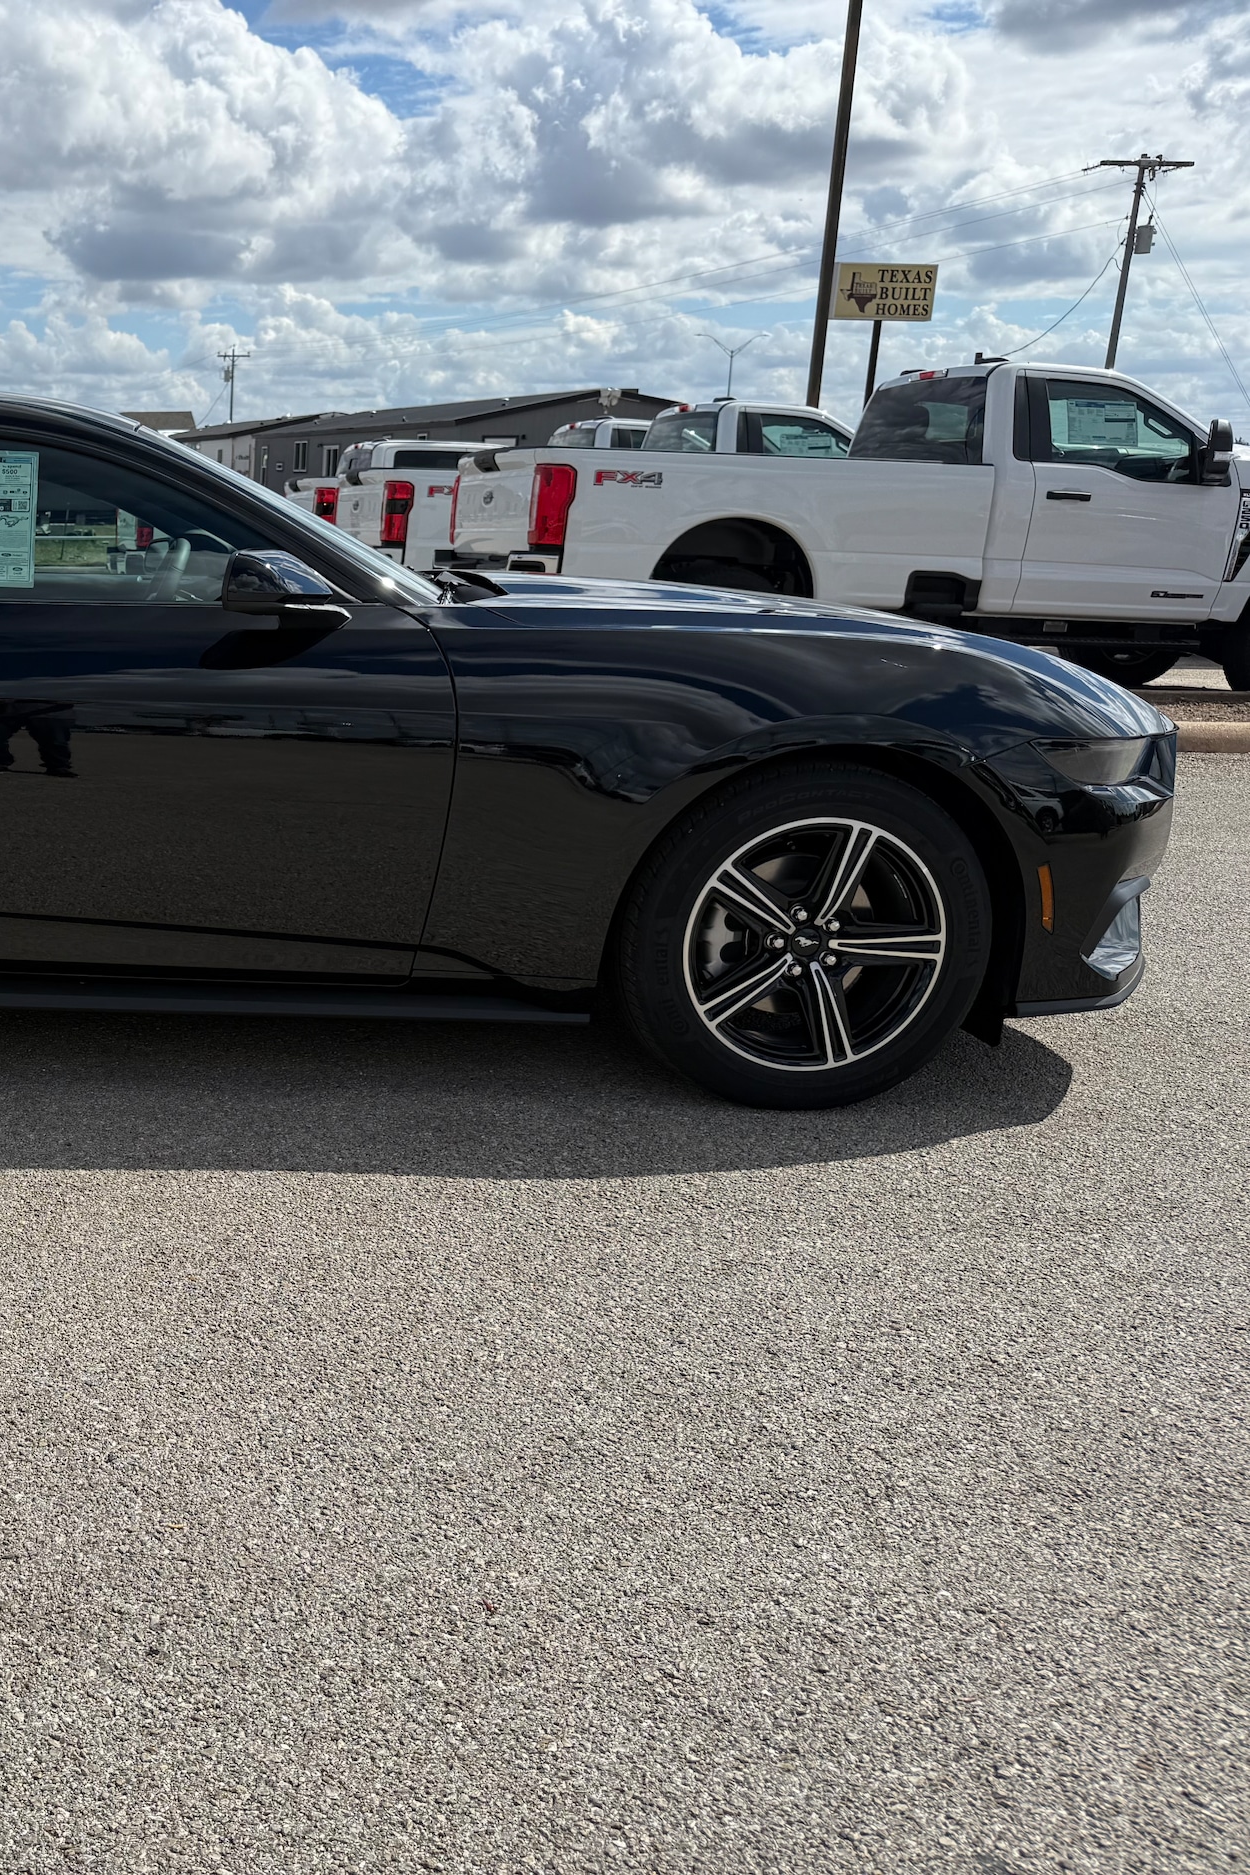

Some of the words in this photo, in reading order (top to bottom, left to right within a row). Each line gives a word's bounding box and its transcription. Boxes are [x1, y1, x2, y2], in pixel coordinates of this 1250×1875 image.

[878, 269, 933, 284] TEXAS
[878, 286, 931, 301] BUILT
[874, 303, 929, 316] HOMES
[593, 469, 663, 486] FX4
[427, 485, 454, 497] FX
[949, 856, 982, 953] Continental
